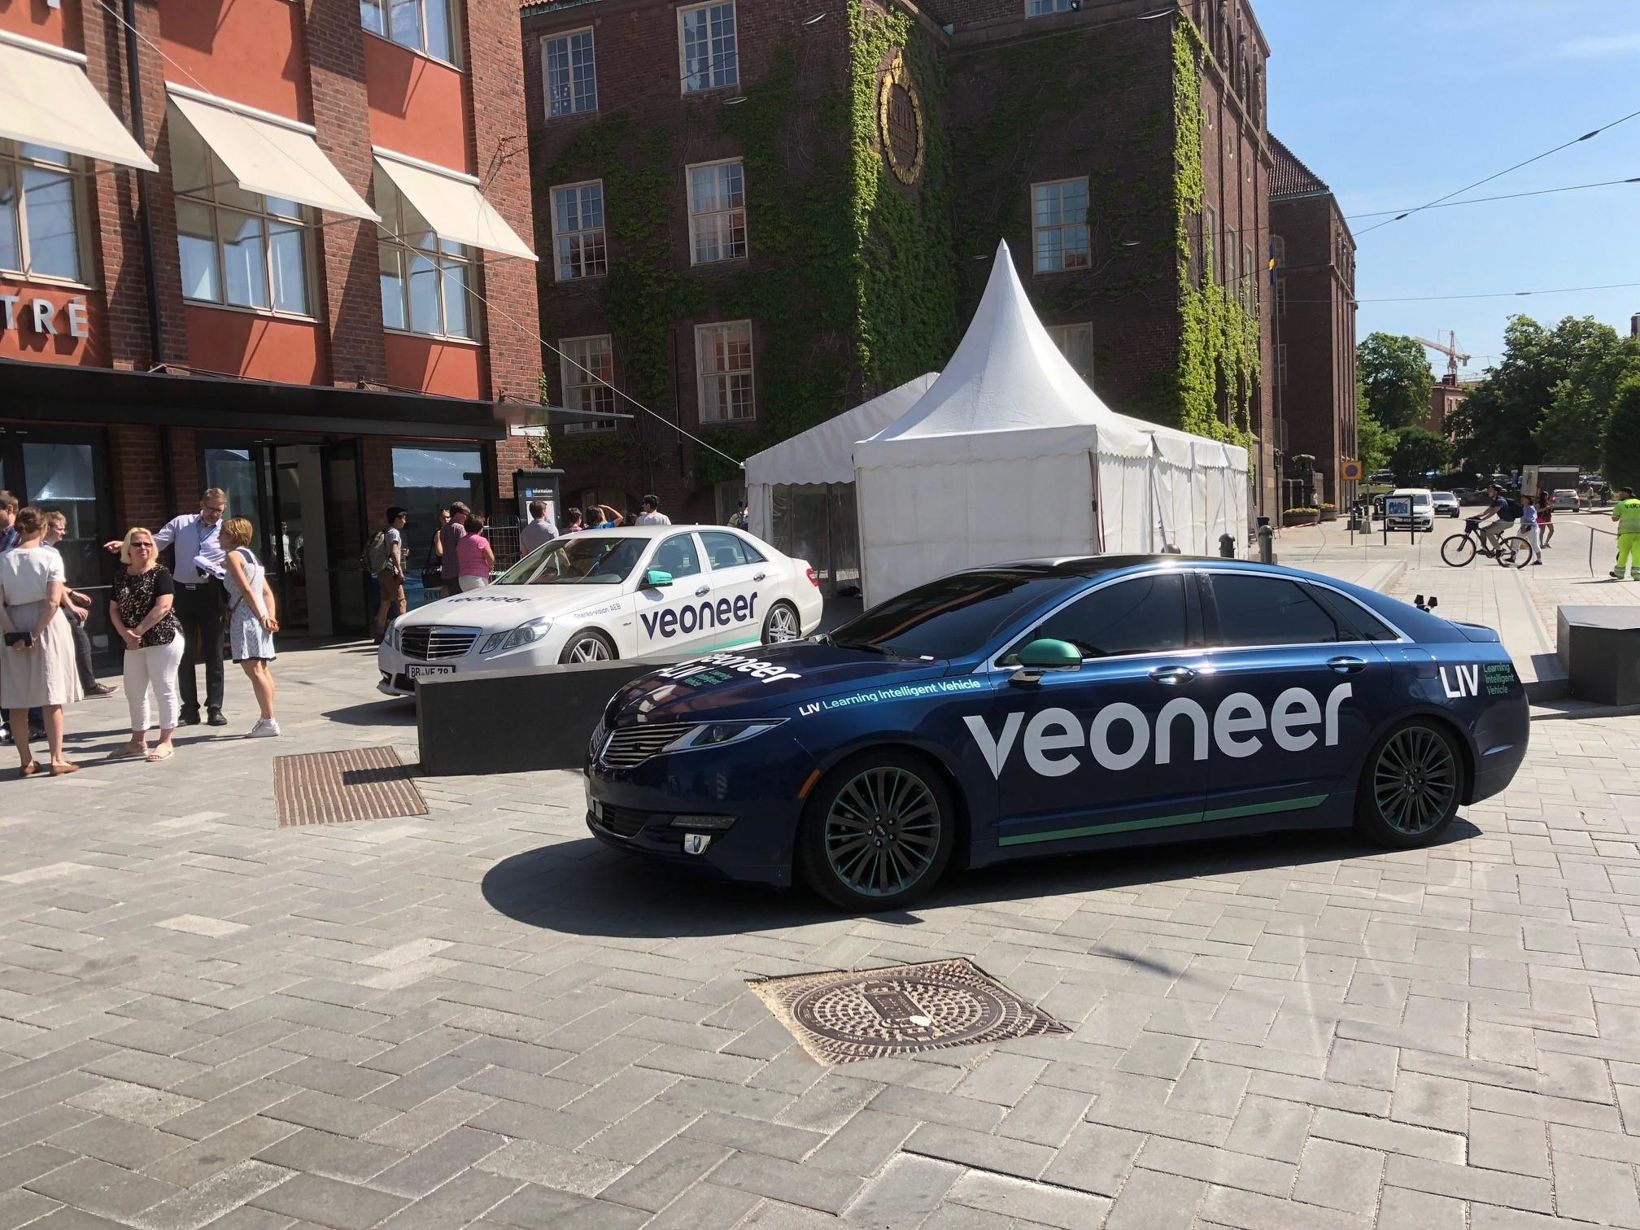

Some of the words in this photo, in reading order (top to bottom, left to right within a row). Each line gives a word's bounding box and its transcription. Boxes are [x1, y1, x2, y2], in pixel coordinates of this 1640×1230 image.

[640, 591, 758, 640] veoneer
[1439, 664, 1479, 698] LIV
[1482, 662, 1511, 673] Learning
[799, 702, 820, 716] LIV
[824, 692, 878, 709] Learning
[880, 683, 937, 698] Intelligent
[938, 678, 981, 692] Vehicle
[1486, 685, 1509, 695] Vehicle
[962, 682, 1353, 781] veoneer
